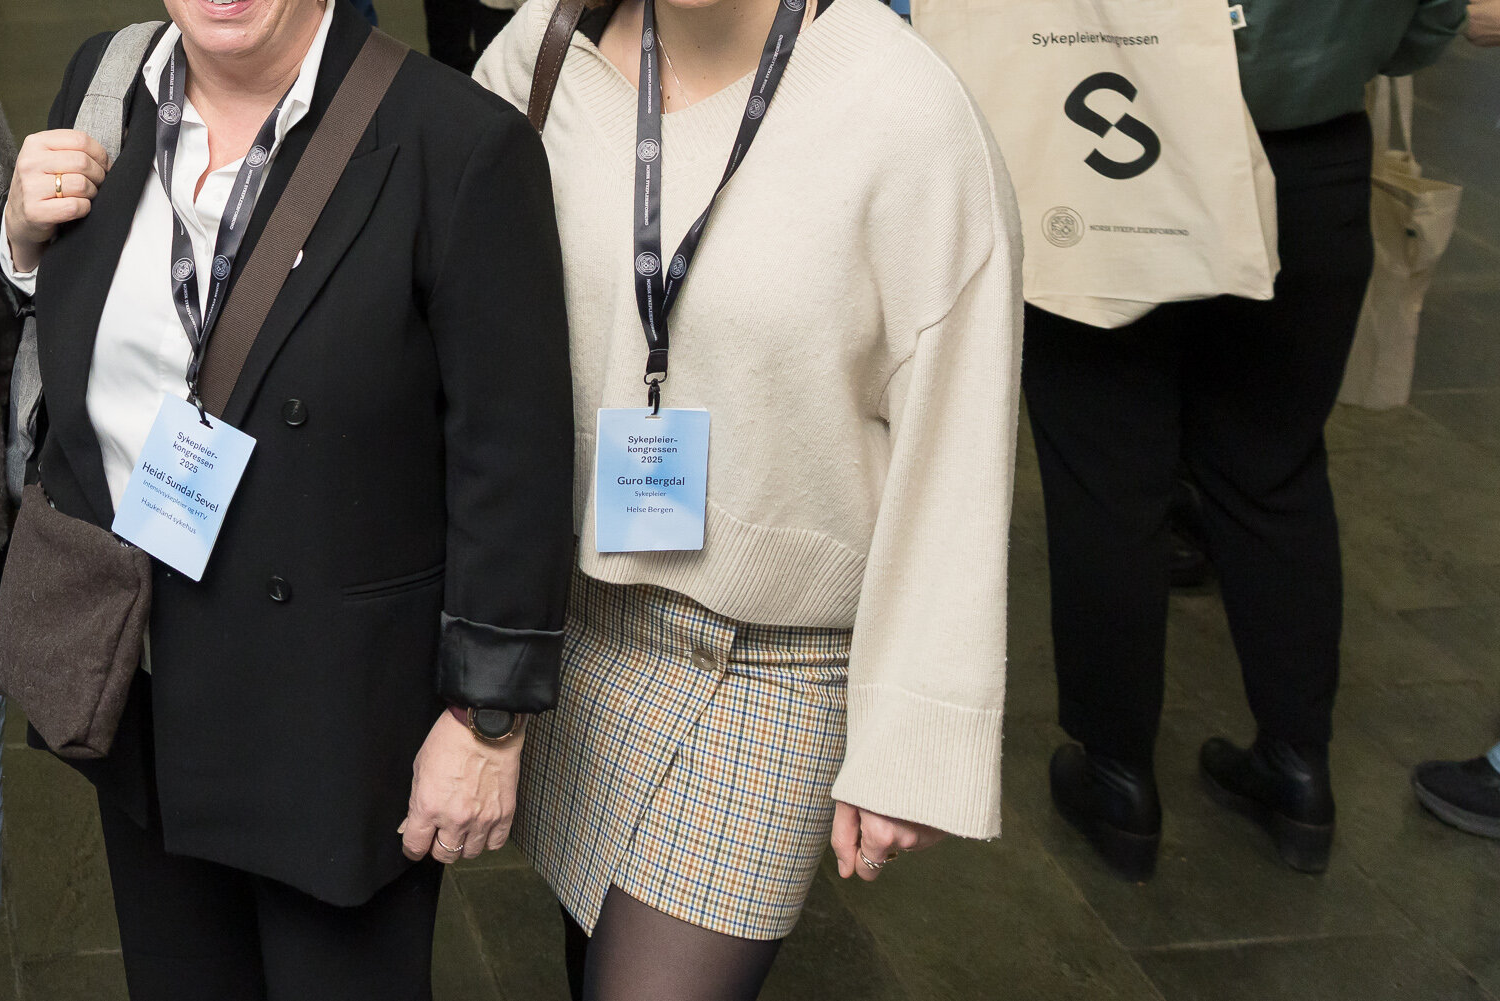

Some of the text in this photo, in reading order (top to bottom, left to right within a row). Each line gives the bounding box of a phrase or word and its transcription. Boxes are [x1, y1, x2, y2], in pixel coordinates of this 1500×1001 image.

[1032, 32, 1159, 47] Sykepleierkongressen
[1064, 71, 1162, 180] S
[176, 431, 218, 459] Sykepleier-
[628, 435, 678, 444] Sykepleier-
[172, 440, 214, 470] kongressen
[627, 445, 678, 454] kongressen
[179, 458, 199, 474] 2025
[641, 456, 663, 464] 2025
[142, 461, 220, 513] Heidi Sundal Sevel
[617, 476, 685, 487] Guro Bergdal
[141, 497, 197, 535] Haukeland sykehus
[647, 506, 674, 514] Bergen
